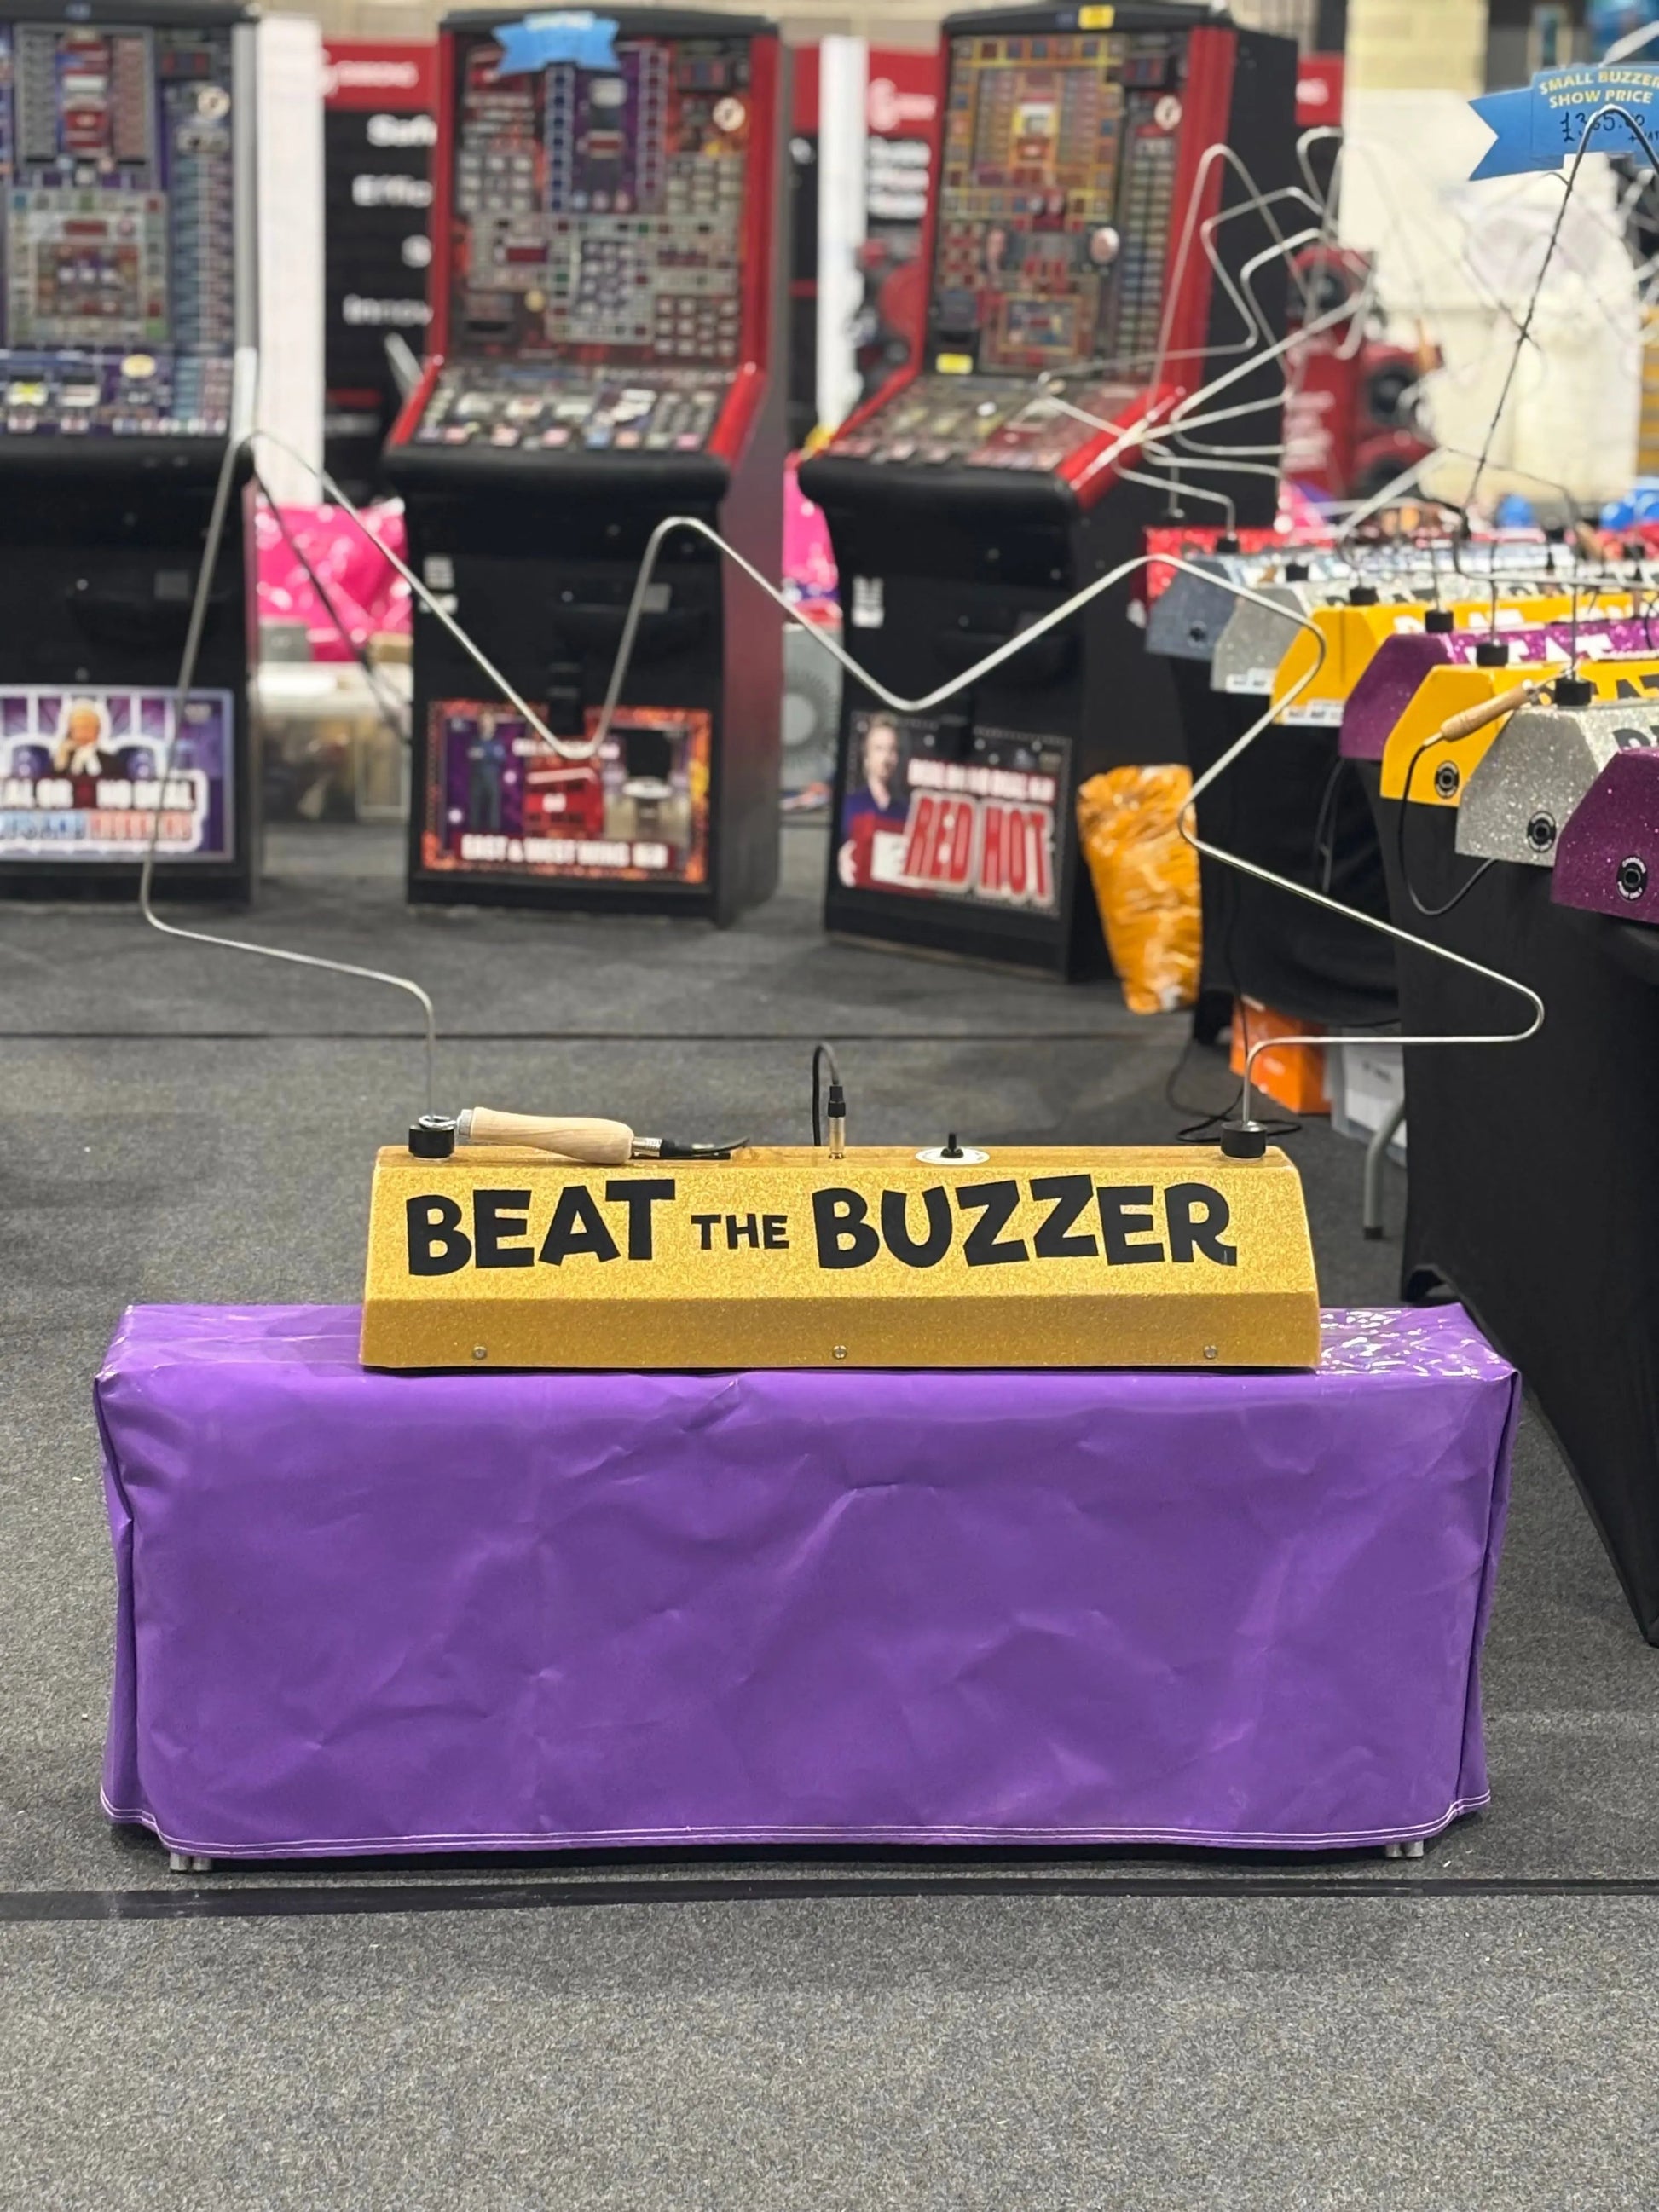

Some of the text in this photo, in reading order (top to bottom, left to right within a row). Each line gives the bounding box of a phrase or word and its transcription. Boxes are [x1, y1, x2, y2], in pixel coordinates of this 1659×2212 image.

[1539, 72, 1594, 95] SMALL
[1549, 89, 1654, 109] SHOW PRICE
[899, 793, 1052, 902] RED HOT
[406, 1174, 1238, 1277] BEAT THE BUZZER
